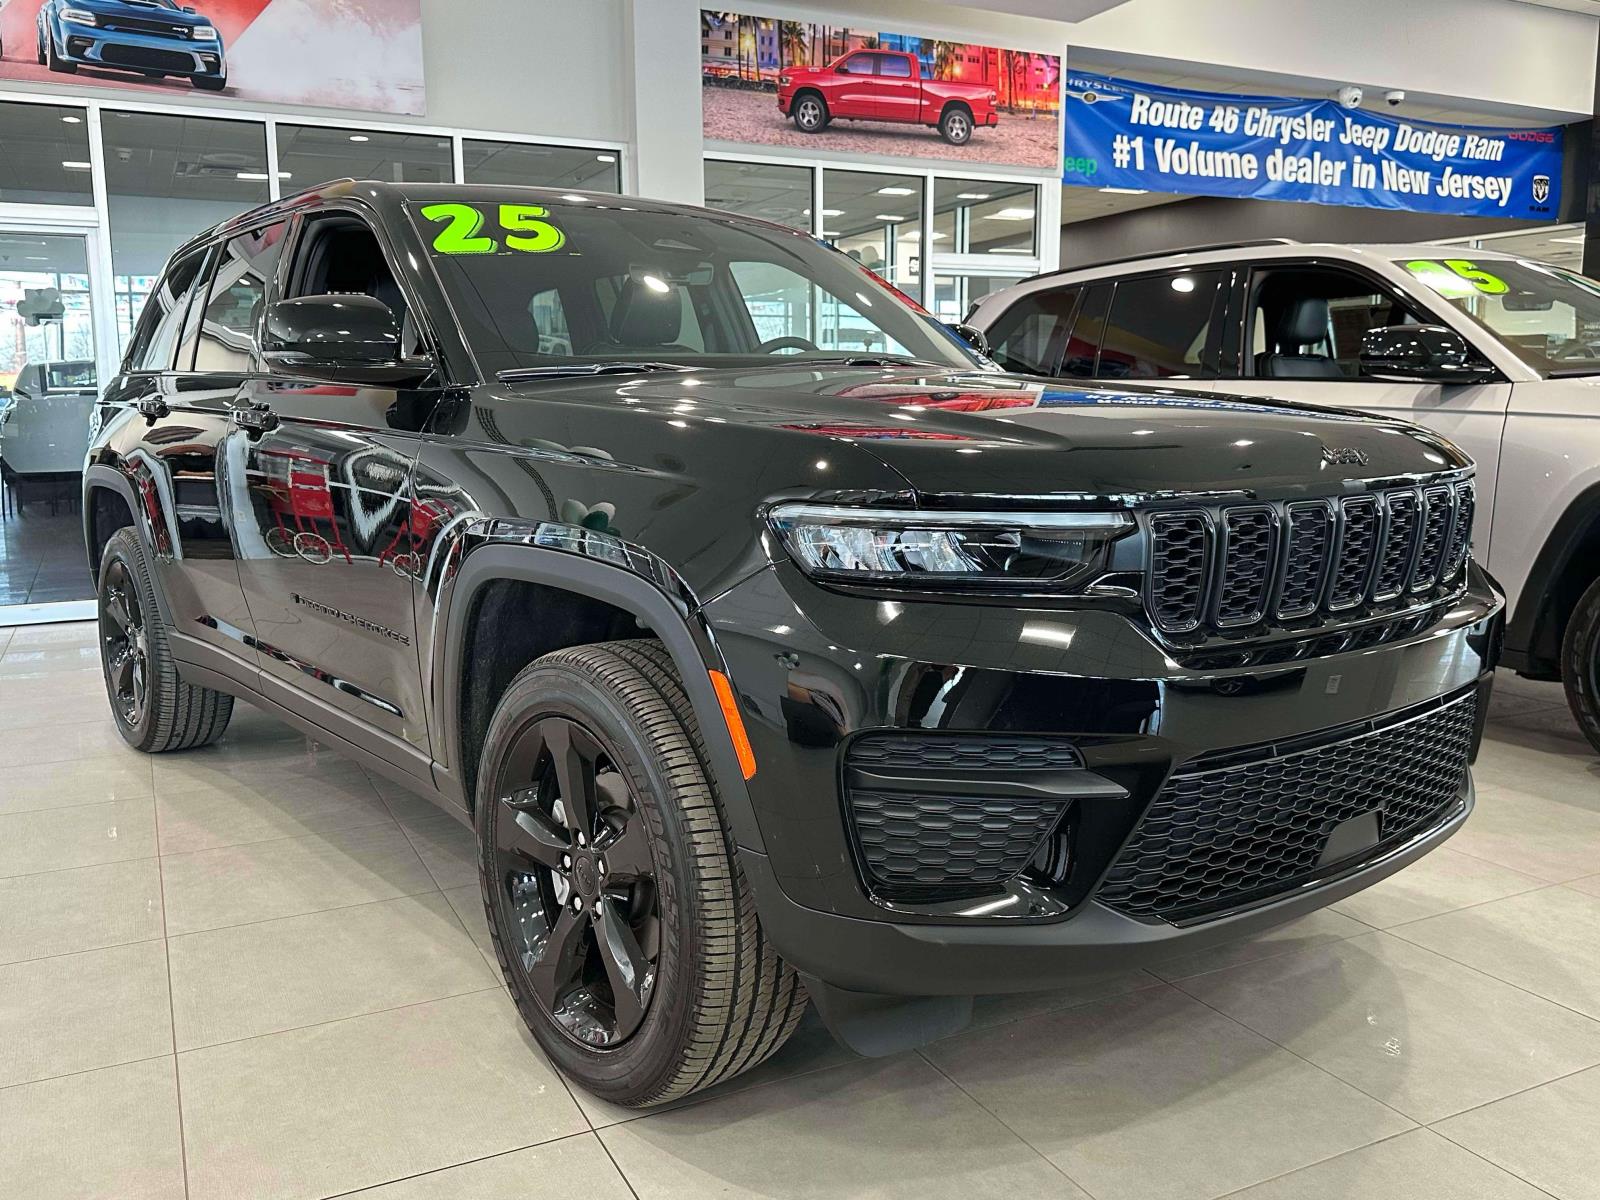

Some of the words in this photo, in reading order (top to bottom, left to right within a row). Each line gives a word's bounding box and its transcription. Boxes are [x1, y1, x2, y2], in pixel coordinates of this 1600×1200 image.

[1130, 93, 1204, 131] Route
[1208, 105, 1239, 134] 46
[1243, 106, 1335, 145] Chrysler
[1339, 117, 1391, 155] Jeep
[1393, 123, 1458, 162] Dodge
[1462, 134, 1505, 161] Ram
[1112, 133, 1145, 171] #1
[1154, 137, 1258, 180] Volume
[1265, 148, 1347, 186] dealer
[1352, 155, 1377, 189] in
[1381, 159, 1430, 195] New
[1435, 166, 1513, 207] Jersey
[420, 203, 566, 254] 25
